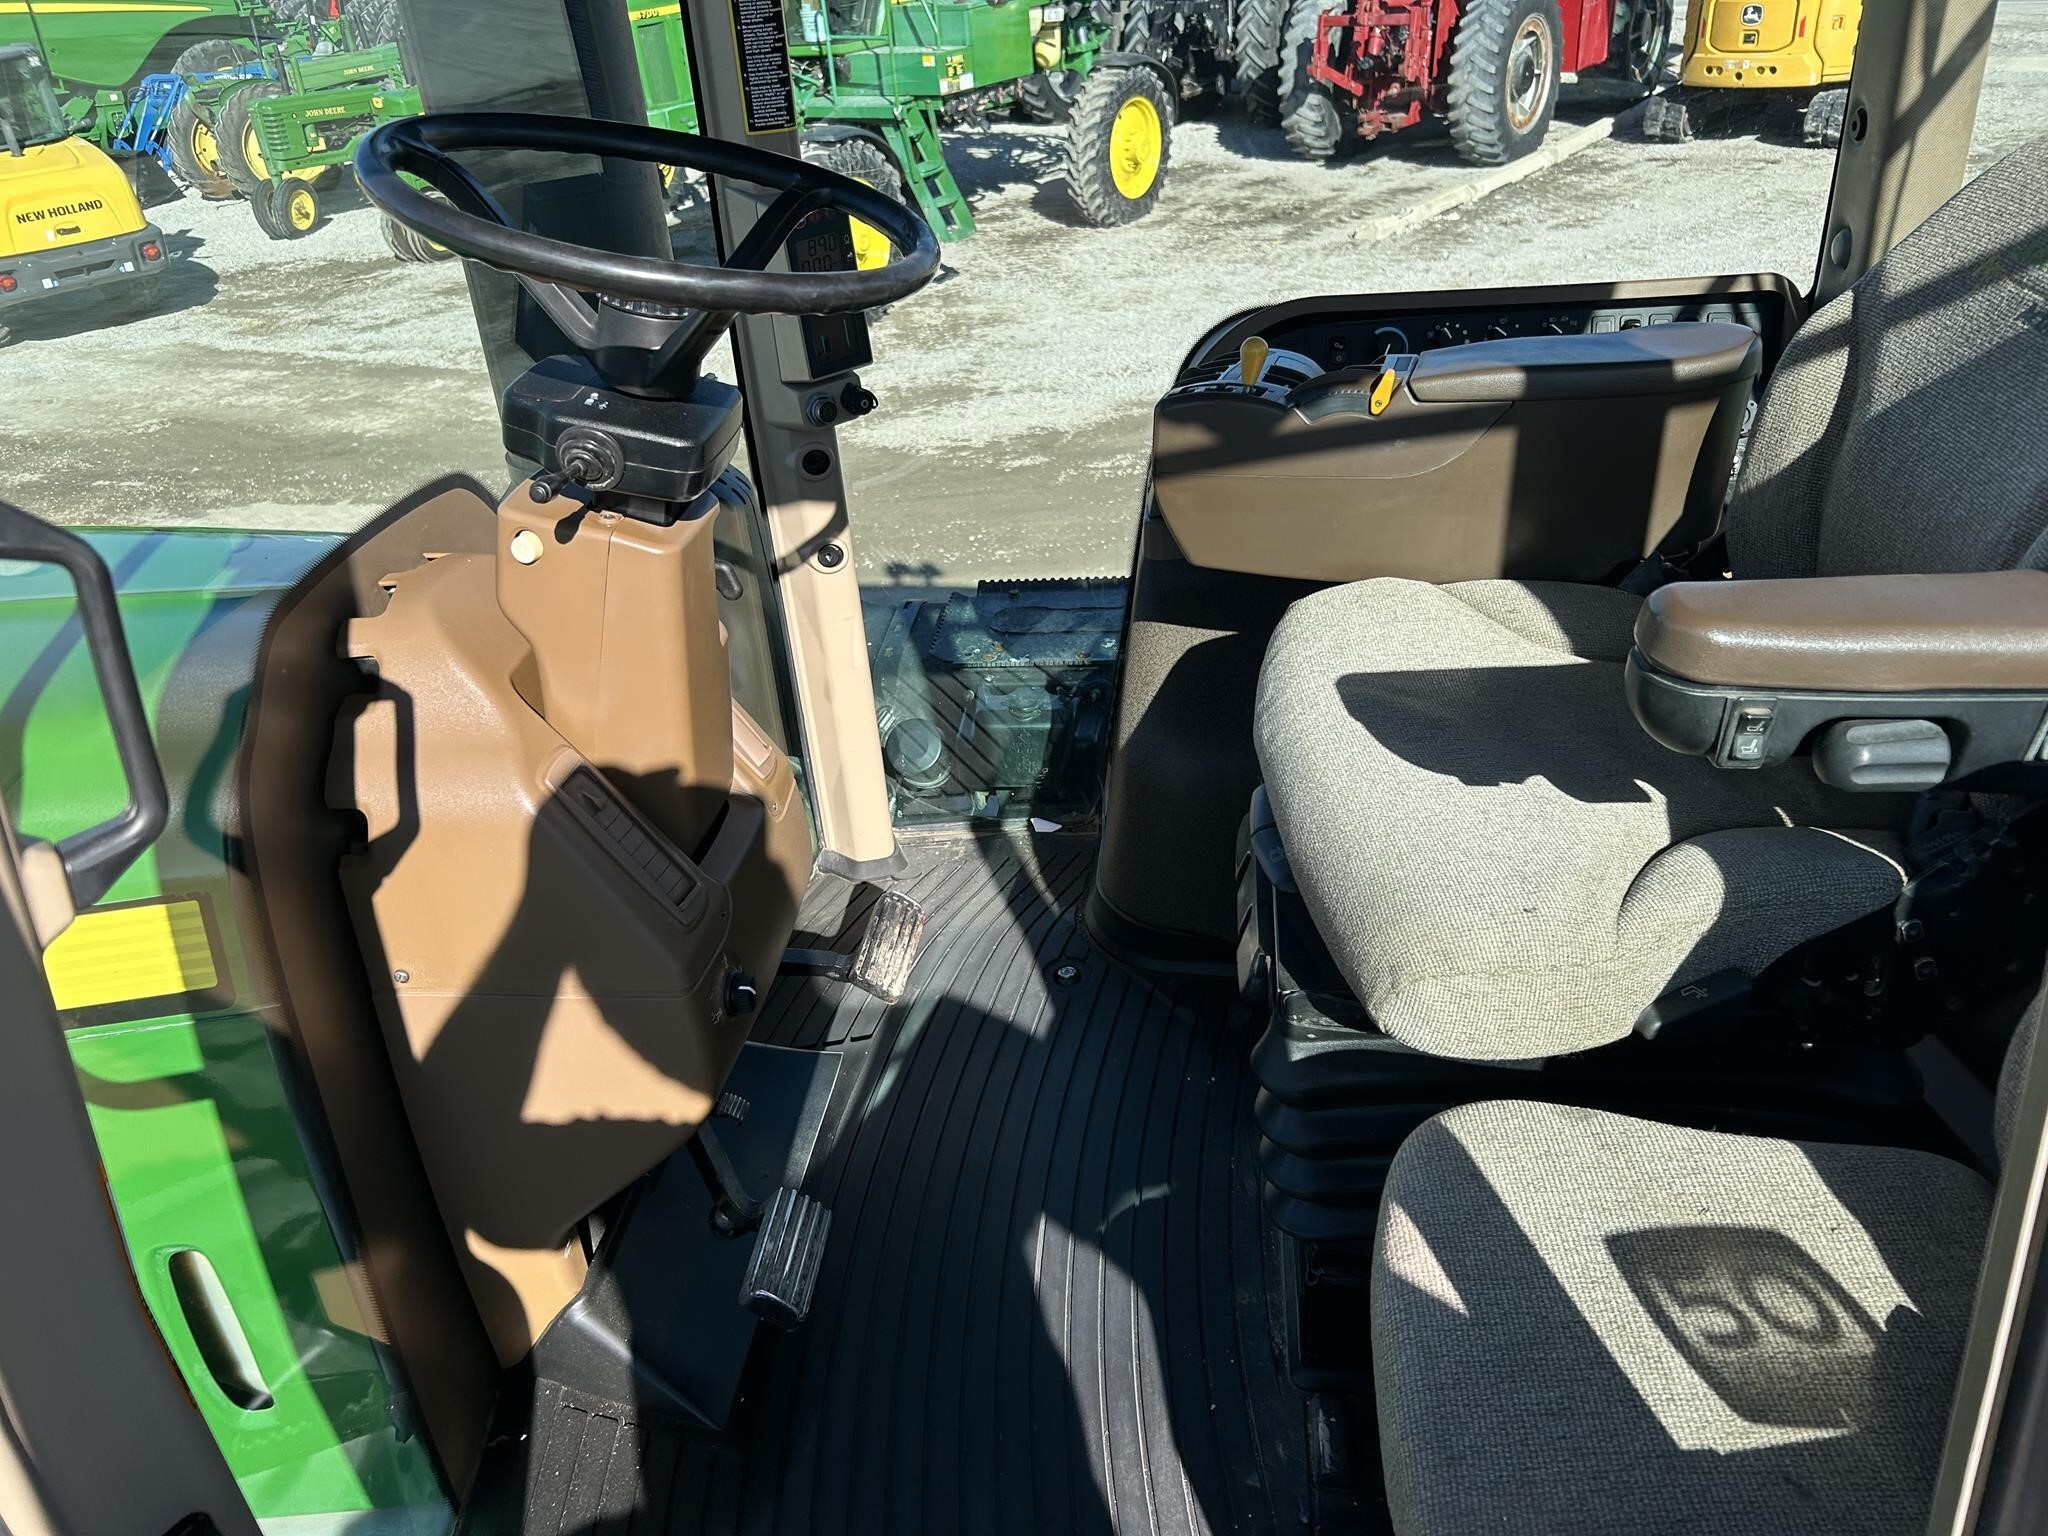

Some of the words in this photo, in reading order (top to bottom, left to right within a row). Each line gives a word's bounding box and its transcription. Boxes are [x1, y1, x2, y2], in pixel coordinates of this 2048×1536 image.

[305, 109, 324, 118] JOHN
[323, 106, 346, 116] DEERE
[15, 209, 46, 225] NEW
[47, 199, 104, 219] HOLLAND
[808, 233, 837, 257] 890
